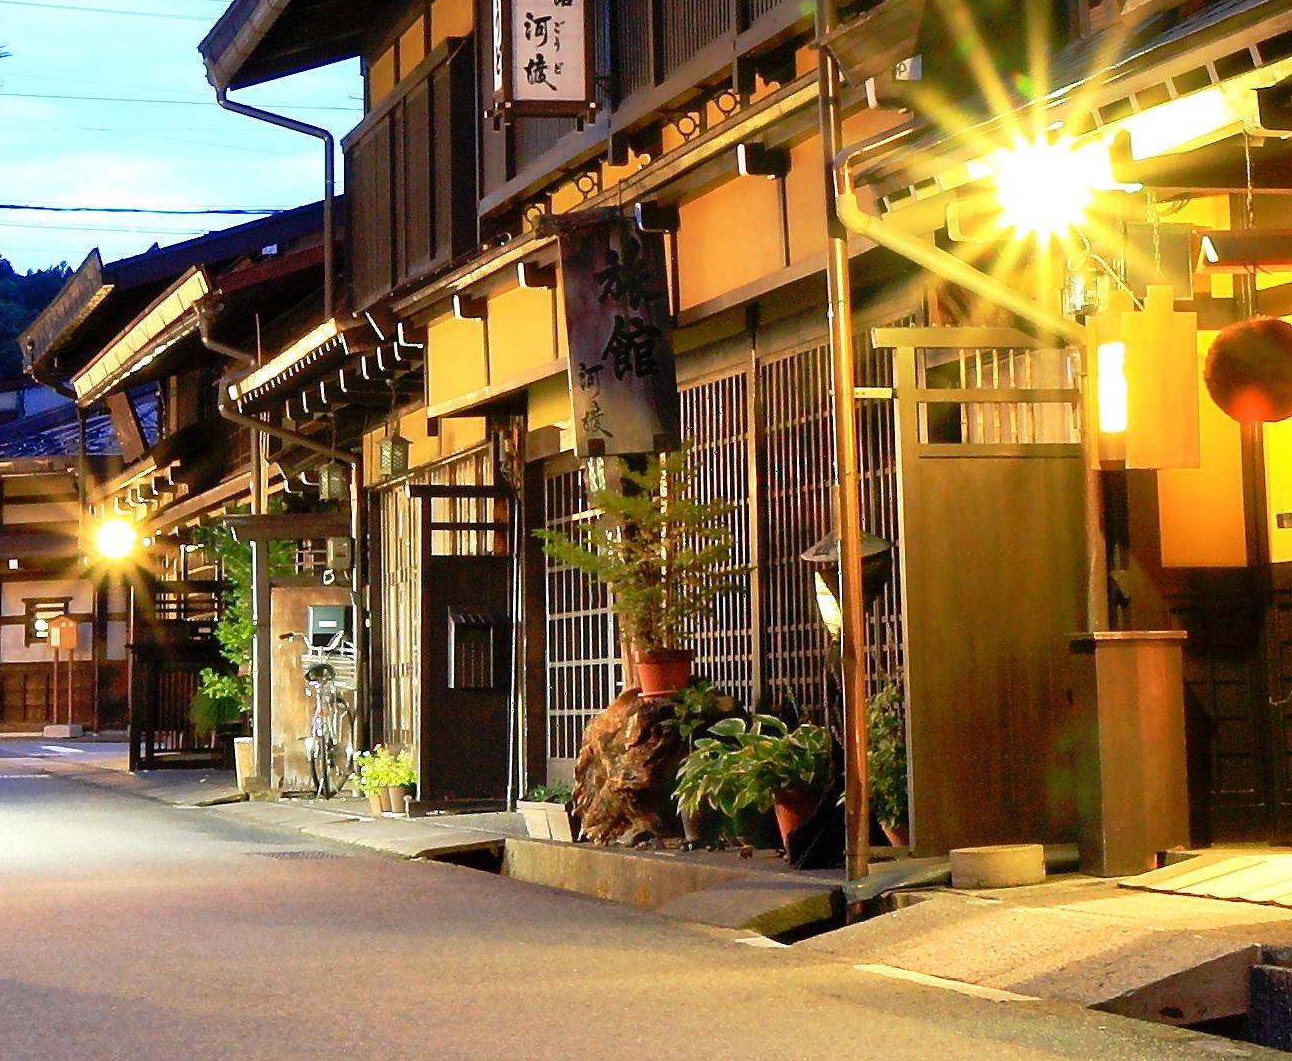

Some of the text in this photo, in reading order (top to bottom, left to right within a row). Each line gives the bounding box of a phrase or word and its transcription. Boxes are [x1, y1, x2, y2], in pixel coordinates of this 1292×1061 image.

[553, 20, 566, 75] ごうど
[593, 236, 662, 381] 旅館
